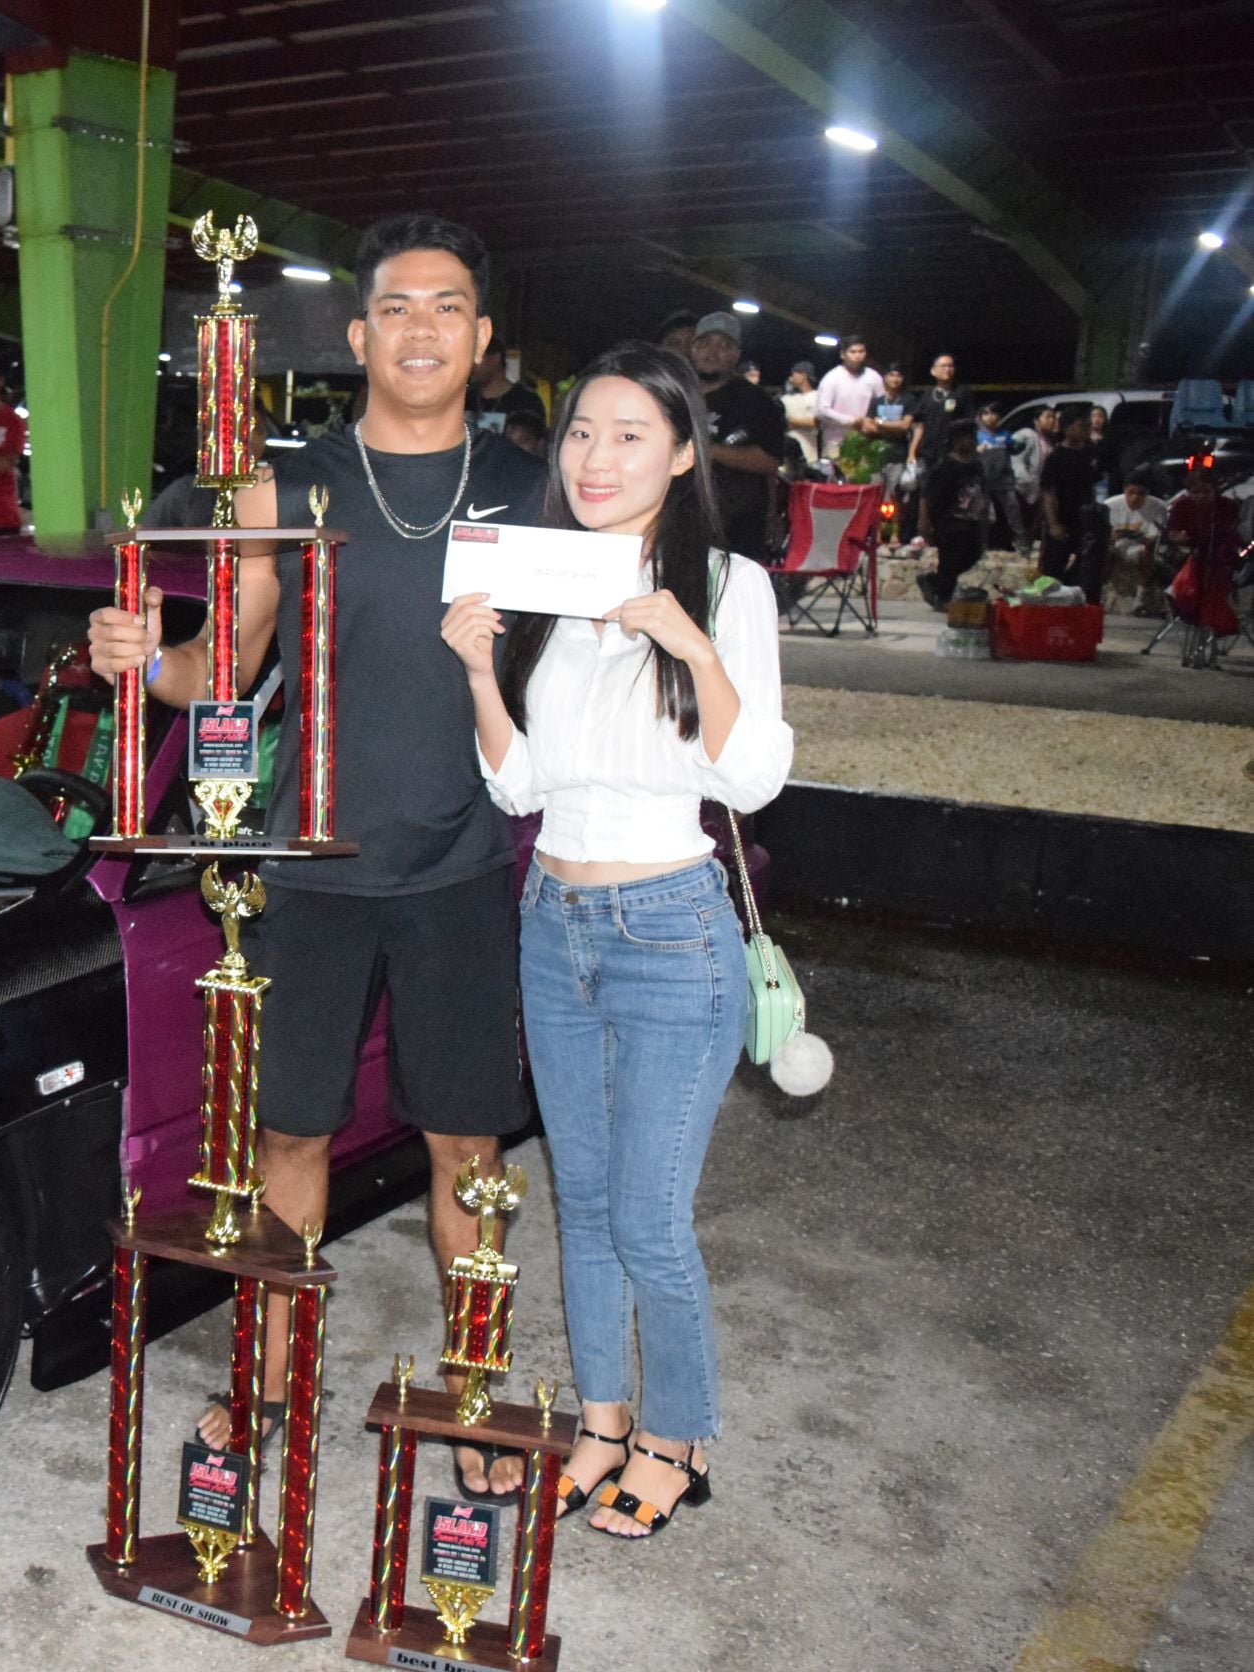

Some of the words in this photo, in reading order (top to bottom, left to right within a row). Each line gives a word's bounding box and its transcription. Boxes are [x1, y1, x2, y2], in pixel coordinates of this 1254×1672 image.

[222, 840, 272, 848] place
[433, 1515, 488, 1537] ISLAND
[152, 1592, 180, 1609] BEST
[180, 1603, 196, 1615] OF
[197, 1608, 231, 1627] SHOW
[397, 1653, 437, 1670] best
